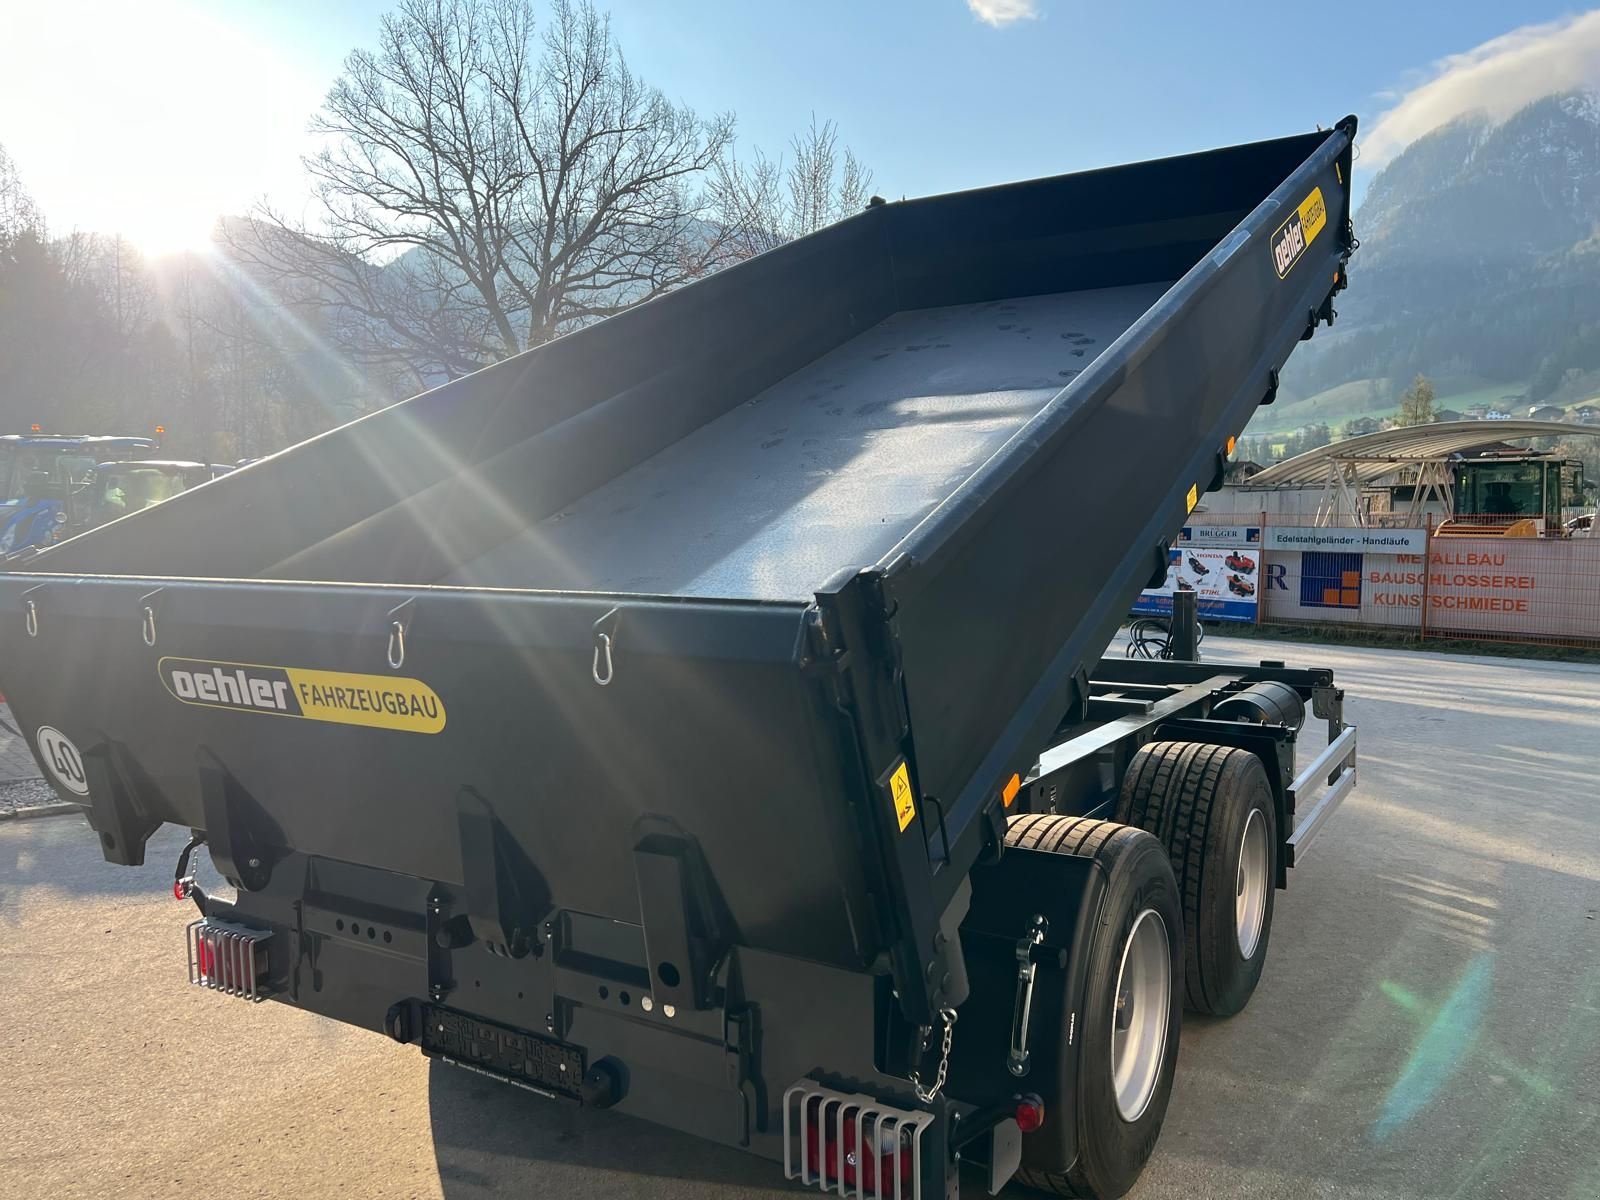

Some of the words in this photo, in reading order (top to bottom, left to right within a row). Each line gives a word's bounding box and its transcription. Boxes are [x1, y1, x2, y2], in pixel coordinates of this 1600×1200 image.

[1275, 221, 1303, 274] oehler
[1277, 534, 1354, 546] Edelstahlgeländer
[1362, 537, 1410, 546] Handläufe
[172, 667, 288, 710] oehler
[299, 683, 438, 719] FAHRZEUGBAU
[46, 739, 85, 783] 40
